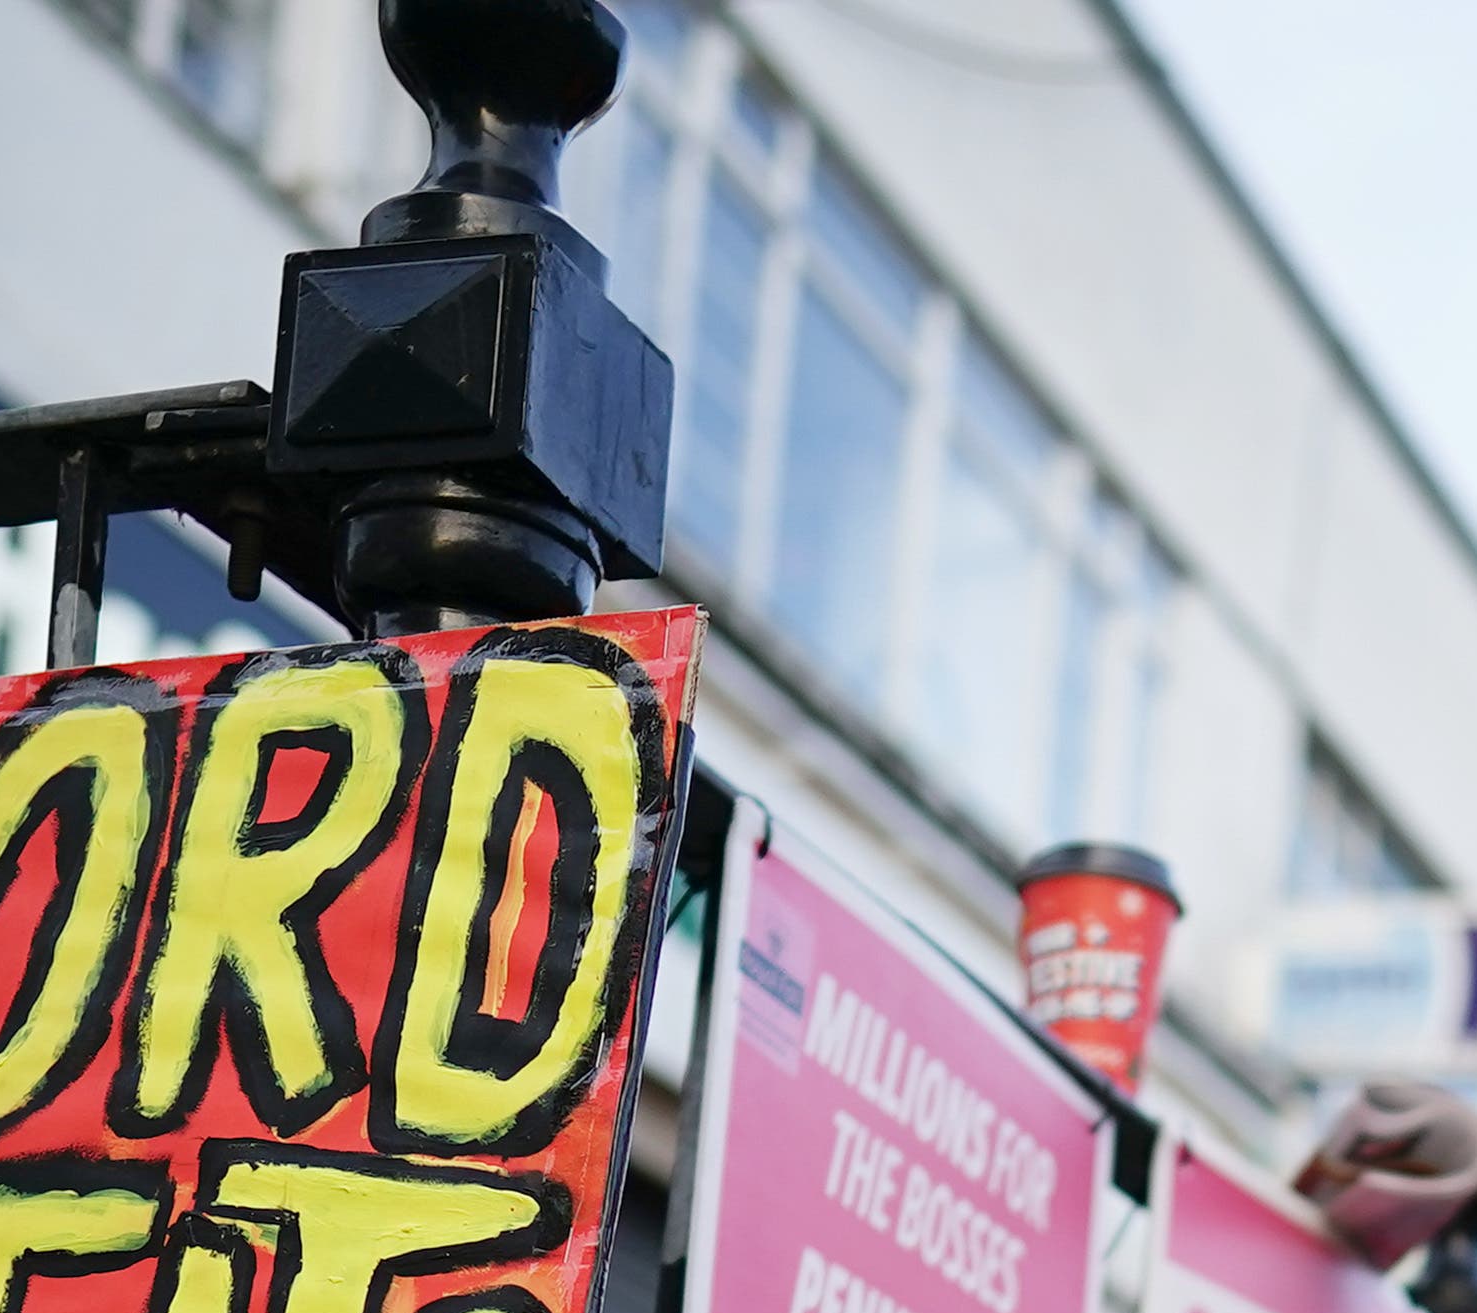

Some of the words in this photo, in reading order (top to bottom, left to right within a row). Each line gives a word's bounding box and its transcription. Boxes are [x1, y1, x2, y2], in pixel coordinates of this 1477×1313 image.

[803, 971, 996, 1181] MILLIONS
[987, 1117, 1057, 1233] FOR
[826, 1108, 903, 1233] THE
